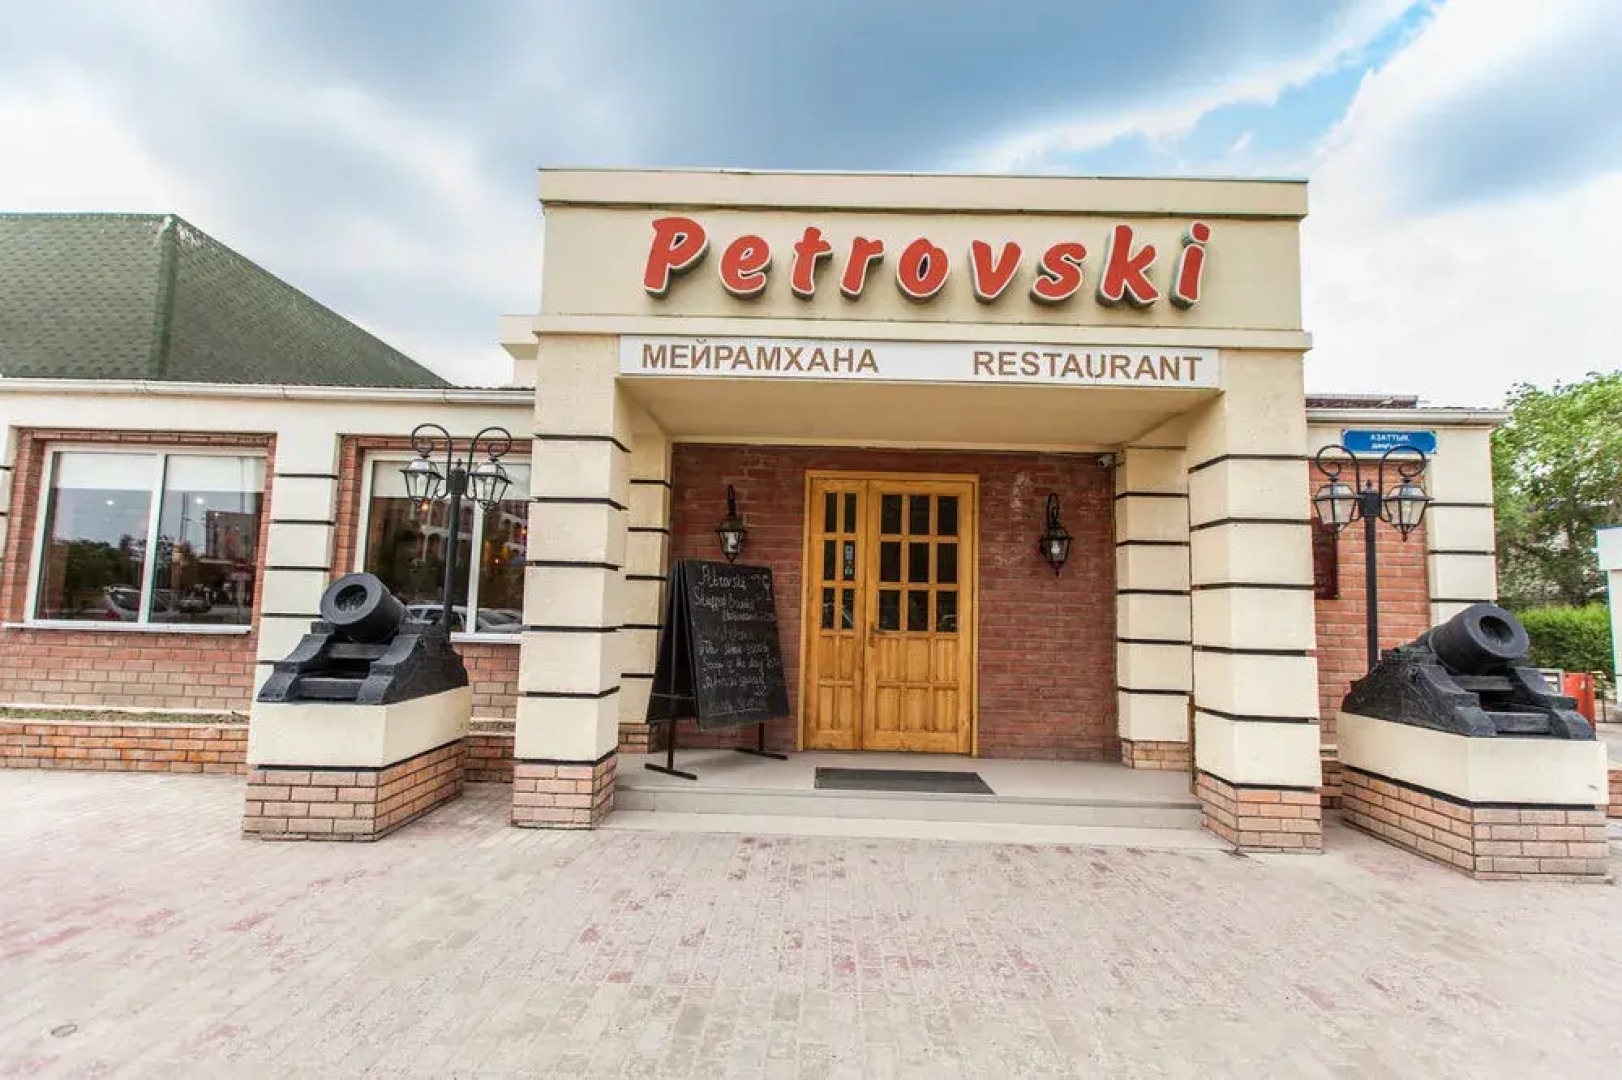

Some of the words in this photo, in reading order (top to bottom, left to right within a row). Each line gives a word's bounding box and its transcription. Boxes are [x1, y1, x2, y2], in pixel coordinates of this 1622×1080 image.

[643, 216, 1211, 308] Petrovski
[641, 339, 880, 373] МЕЙРАМХАНА
[973, 350, 1203, 381] RESTAURANT
